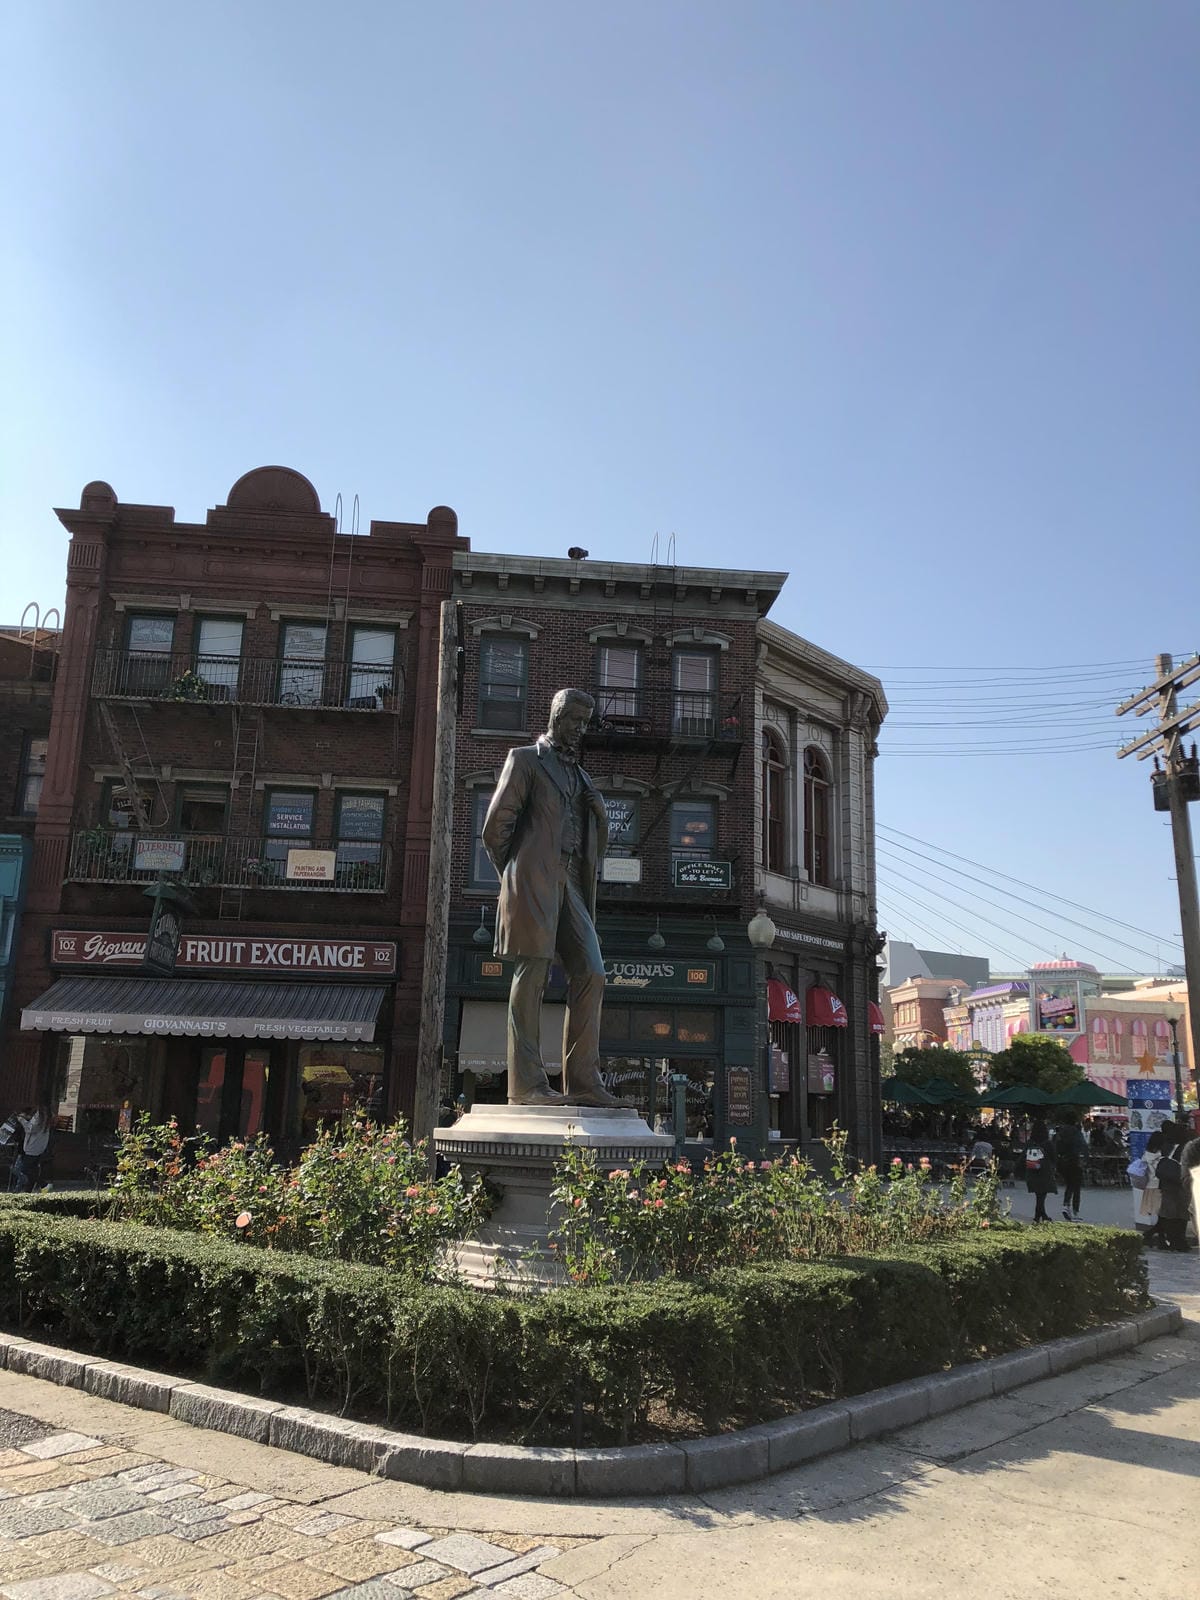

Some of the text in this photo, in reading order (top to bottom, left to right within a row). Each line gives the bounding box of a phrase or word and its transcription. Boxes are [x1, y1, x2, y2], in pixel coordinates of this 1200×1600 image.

[277, 813, 303, 821] SERVICE
[270, 822, 310, 830] INSTALLATION
[608, 821, 631, 832] PPLY
[679, 863, 725, 875] OFFICE SPACE
[775, 929, 844, 950] SLAND SAFE DEPOSIT COMPANY
[59, 940, 76, 951] 102
[185, 940, 246, 963] FRUIT
[250, 942, 366, 968] EXCHANGE
[375, 951, 390, 961] 102
[690, 972, 704, 980] 100
[51, 1016, 84, 1025] FRESH
[85, 1017, 112, 1026] FRUIT
[143, 1019, 227, 1031] GIOVANNASI'S
[254, 1023, 285, 1032] FRESH
[288, 1024, 348, 1034] VEGETABLES
